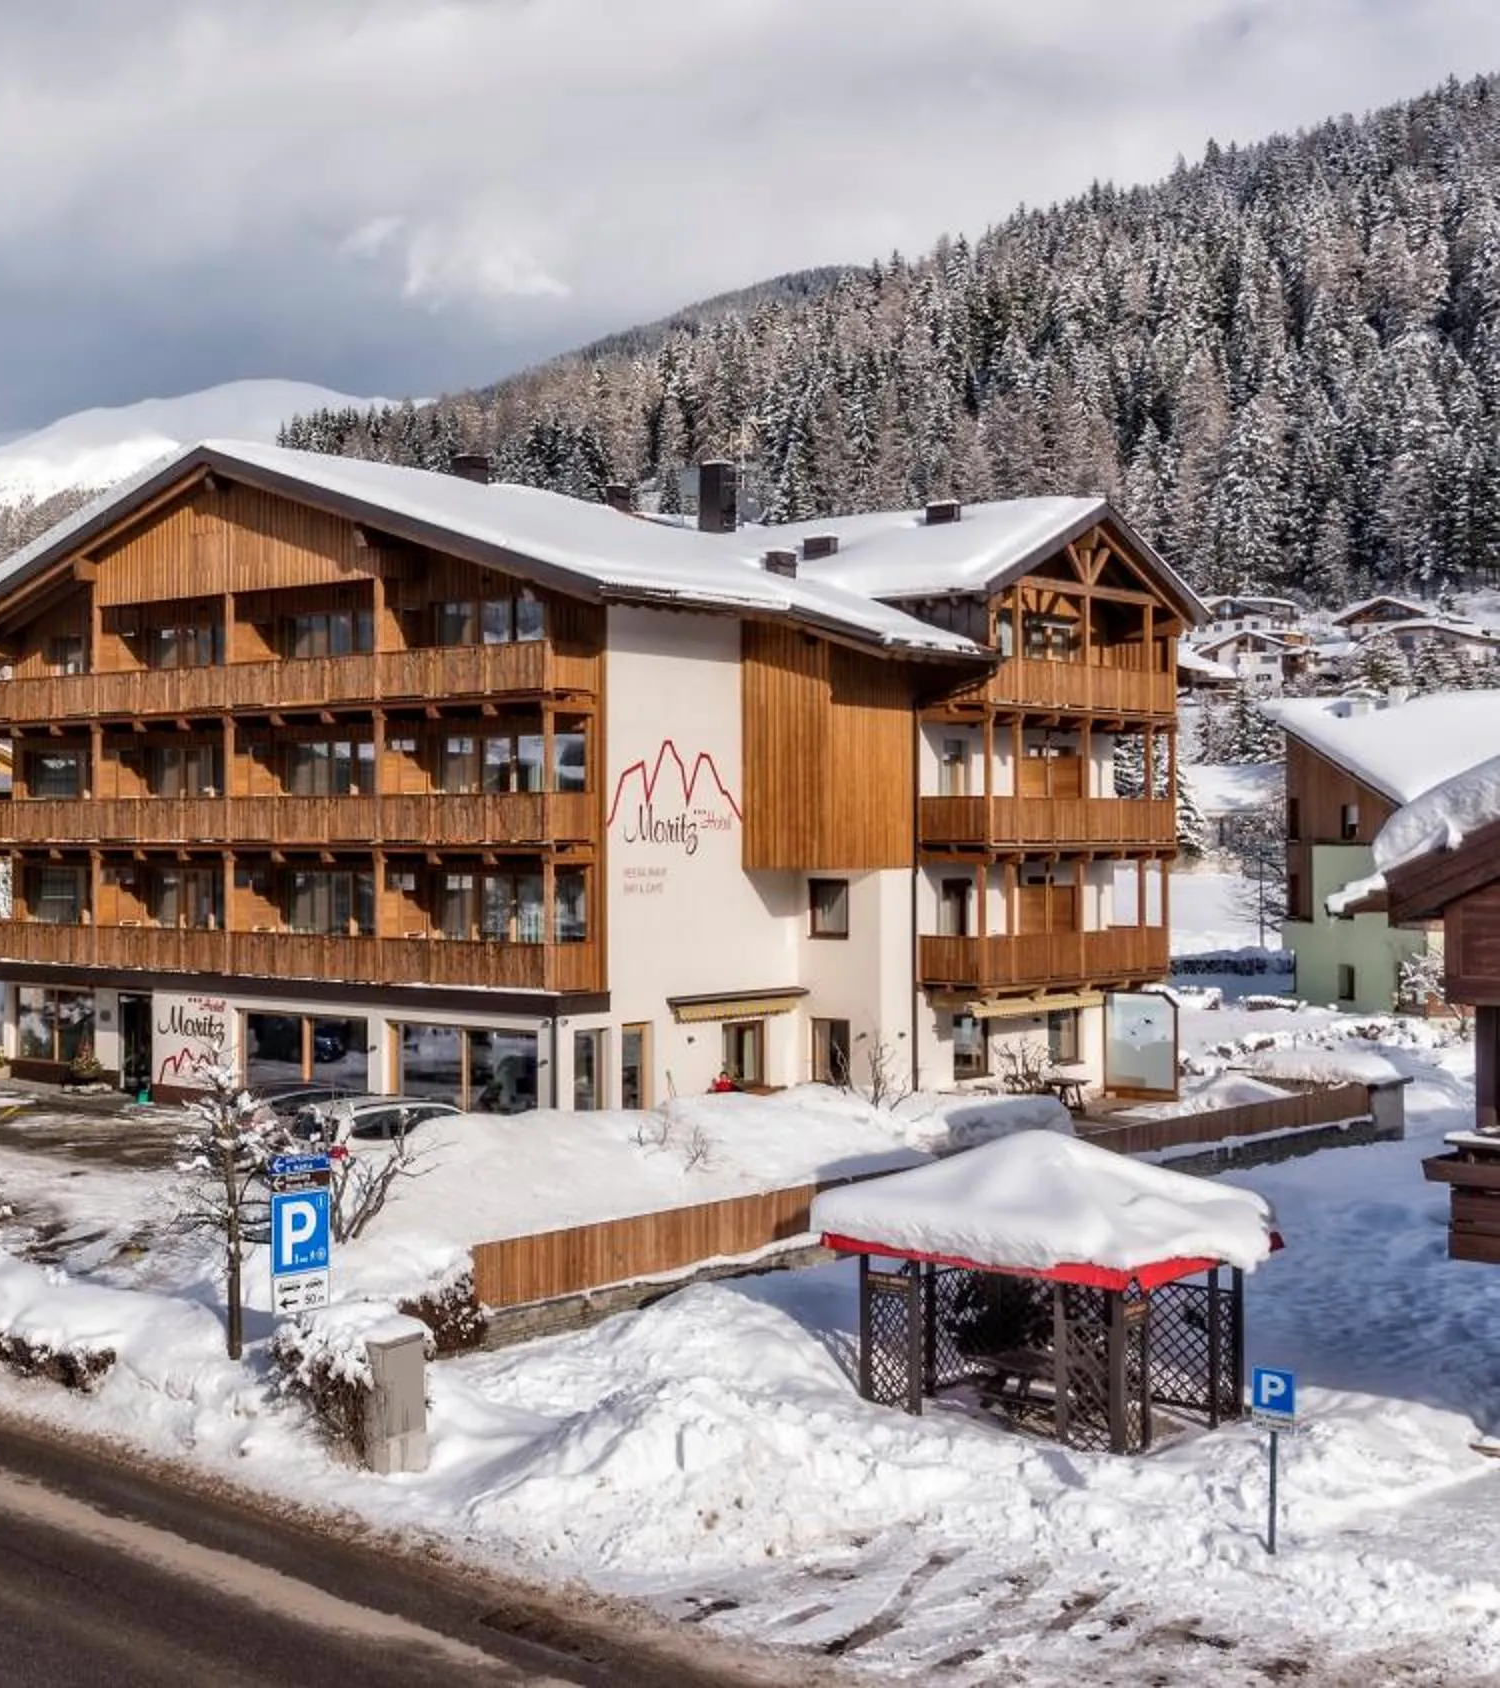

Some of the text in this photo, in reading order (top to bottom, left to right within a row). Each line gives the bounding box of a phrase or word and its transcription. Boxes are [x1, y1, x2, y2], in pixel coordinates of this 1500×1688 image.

[623, 803, 699, 855] Moritz
[157, 1005, 225, 1050] Moritz
[281, 1201, 317, 1266] P
[1260, 1372, 1286, 1405] P
